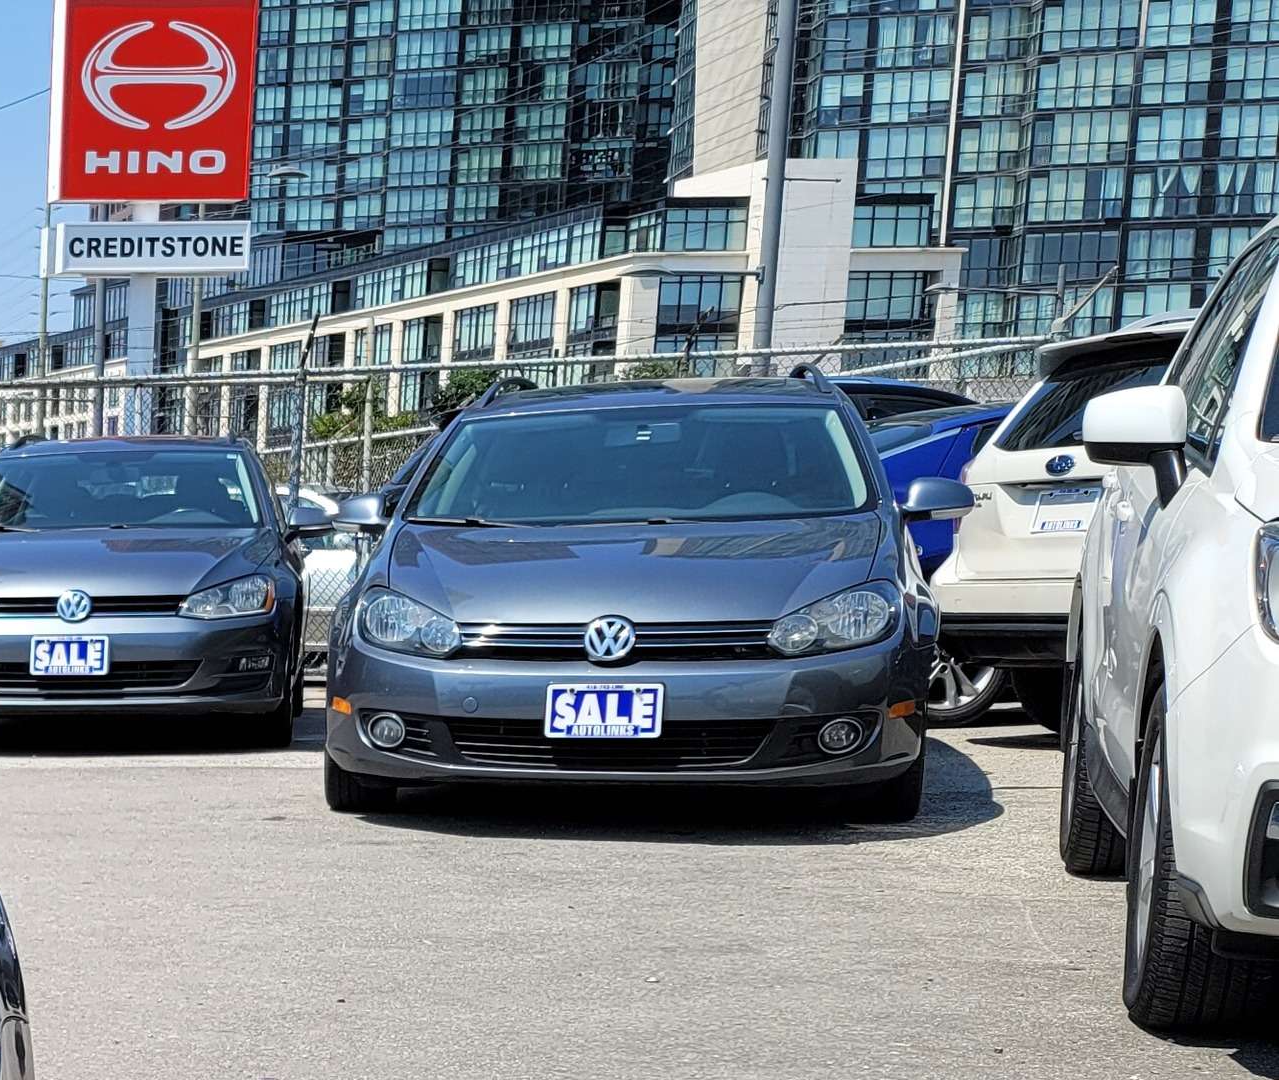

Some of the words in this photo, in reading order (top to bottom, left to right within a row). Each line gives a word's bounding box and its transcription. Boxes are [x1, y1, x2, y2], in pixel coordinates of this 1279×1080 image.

[84, 149, 227, 175] HINO
[68, 235, 244, 259] CREDITSTONE
[34, 642, 102, 671] SALE
[552, 692, 655, 729] SALE
[571, 724, 635, 736] AUTOLINKS
